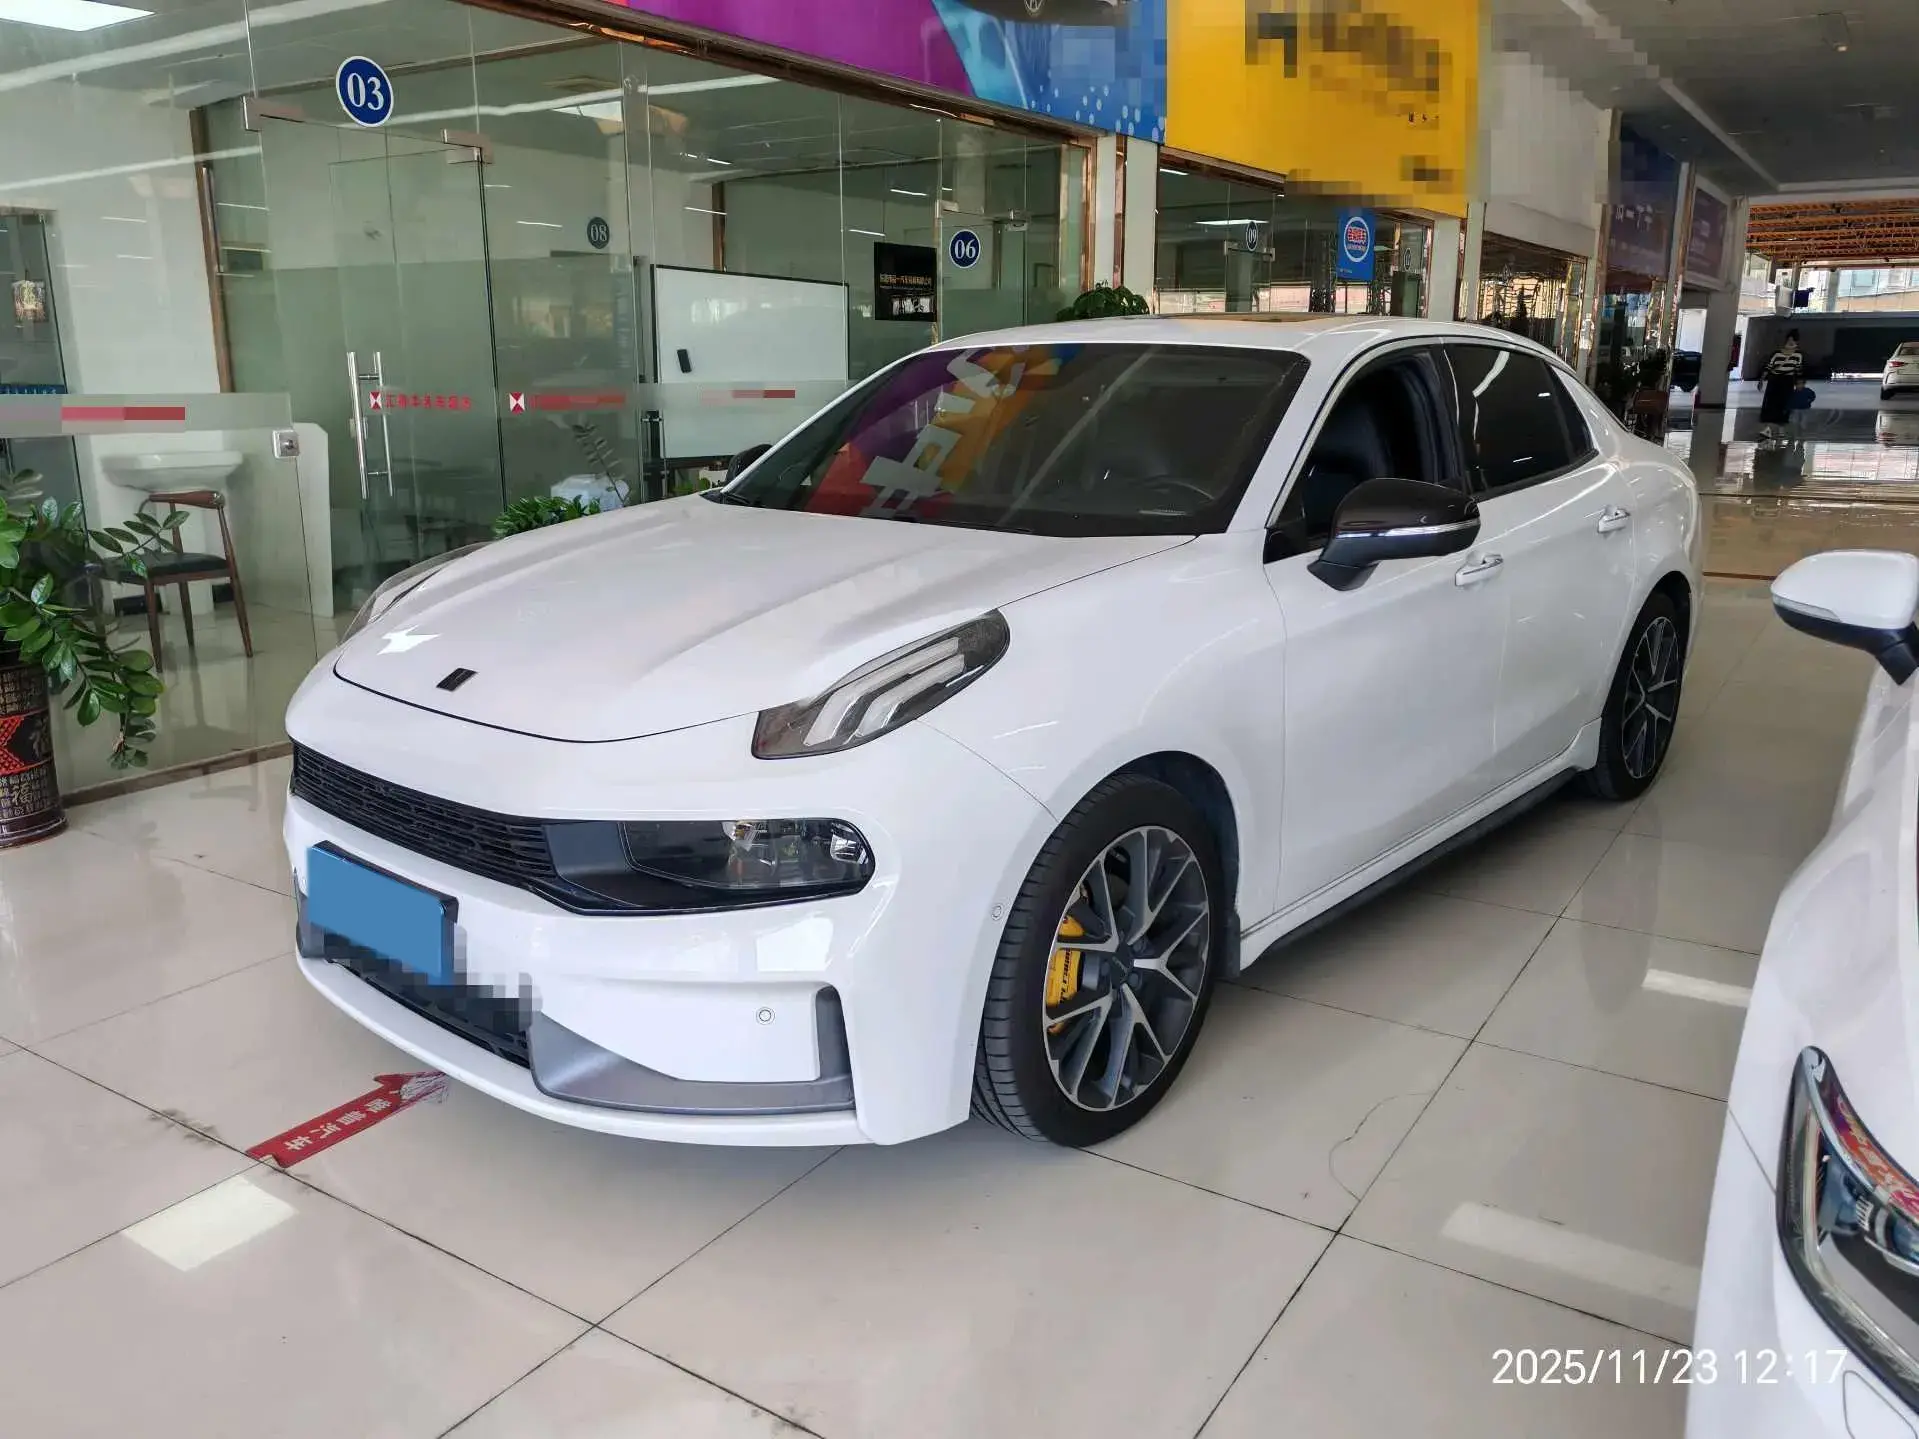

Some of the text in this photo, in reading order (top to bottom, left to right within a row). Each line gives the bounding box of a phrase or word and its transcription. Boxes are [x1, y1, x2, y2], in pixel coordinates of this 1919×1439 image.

[347, 73, 385, 111] 03
[591, 224, 607, 241] 08
[1248, 228, 1257, 244] 09
[955, 239, 976, 259] 06
